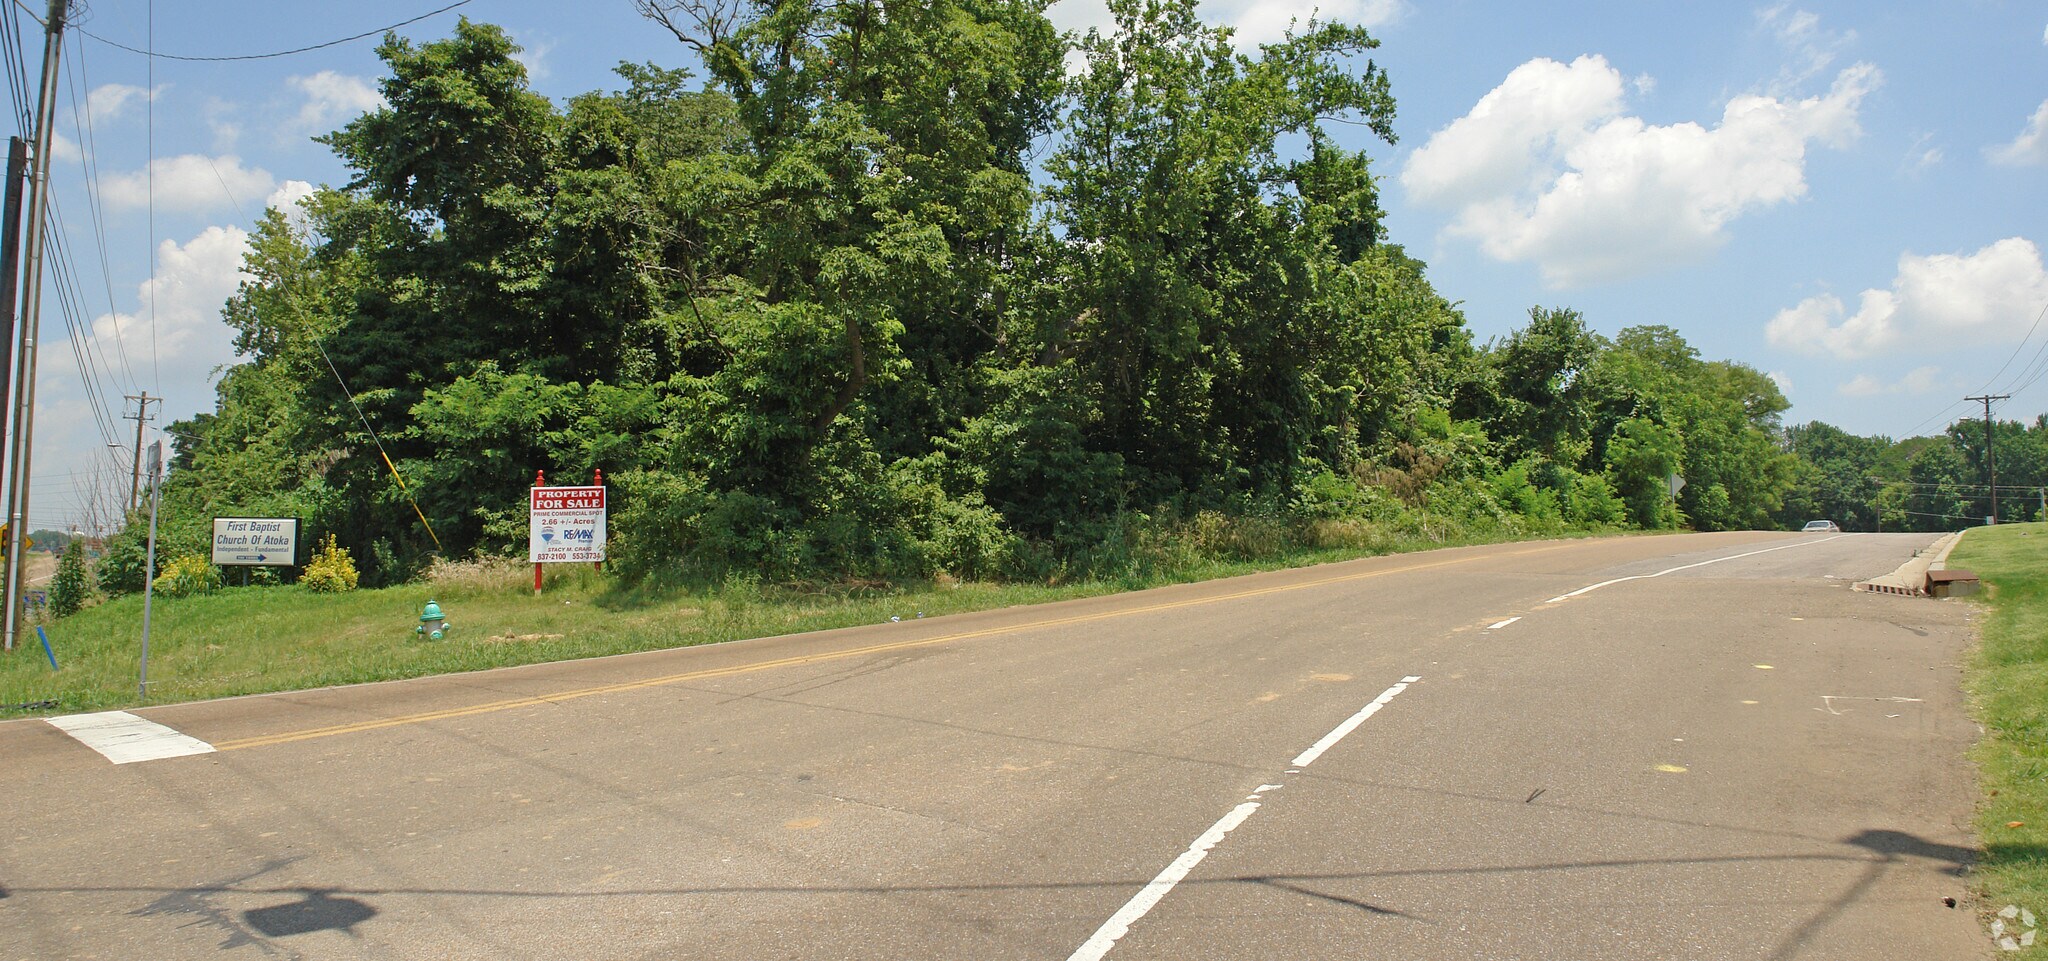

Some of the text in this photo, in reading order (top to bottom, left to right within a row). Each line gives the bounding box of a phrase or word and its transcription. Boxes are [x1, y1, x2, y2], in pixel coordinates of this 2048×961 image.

[538, 490, 601, 498] PROPERTY
[536, 499, 600, 509] FOR SALE
[227, 521, 281, 533] First Baptist
[217, 534, 289, 546] Church Of Atoka
[564, 528, 594, 540] RE/MAX
